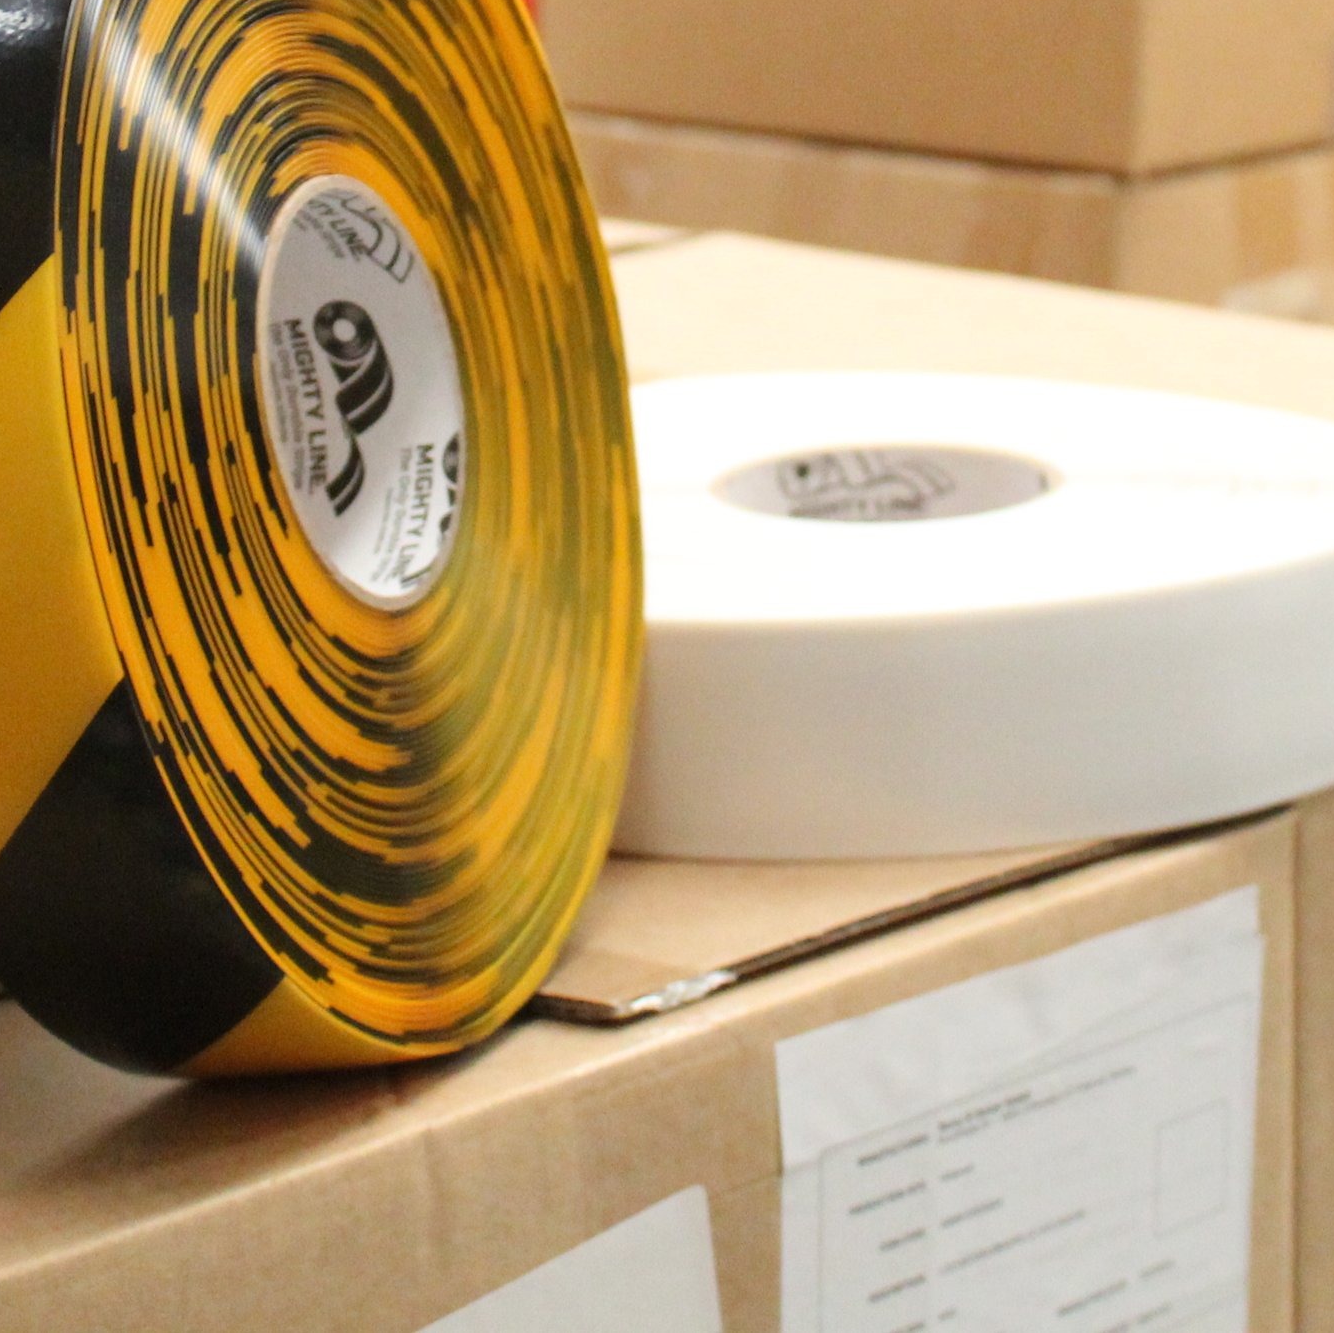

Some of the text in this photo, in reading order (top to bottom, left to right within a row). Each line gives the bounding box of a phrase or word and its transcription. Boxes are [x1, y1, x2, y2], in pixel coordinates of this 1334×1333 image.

[283, 318, 327, 488] MIGHTY LINE
[406, 443, 435, 537] MIGHTY
